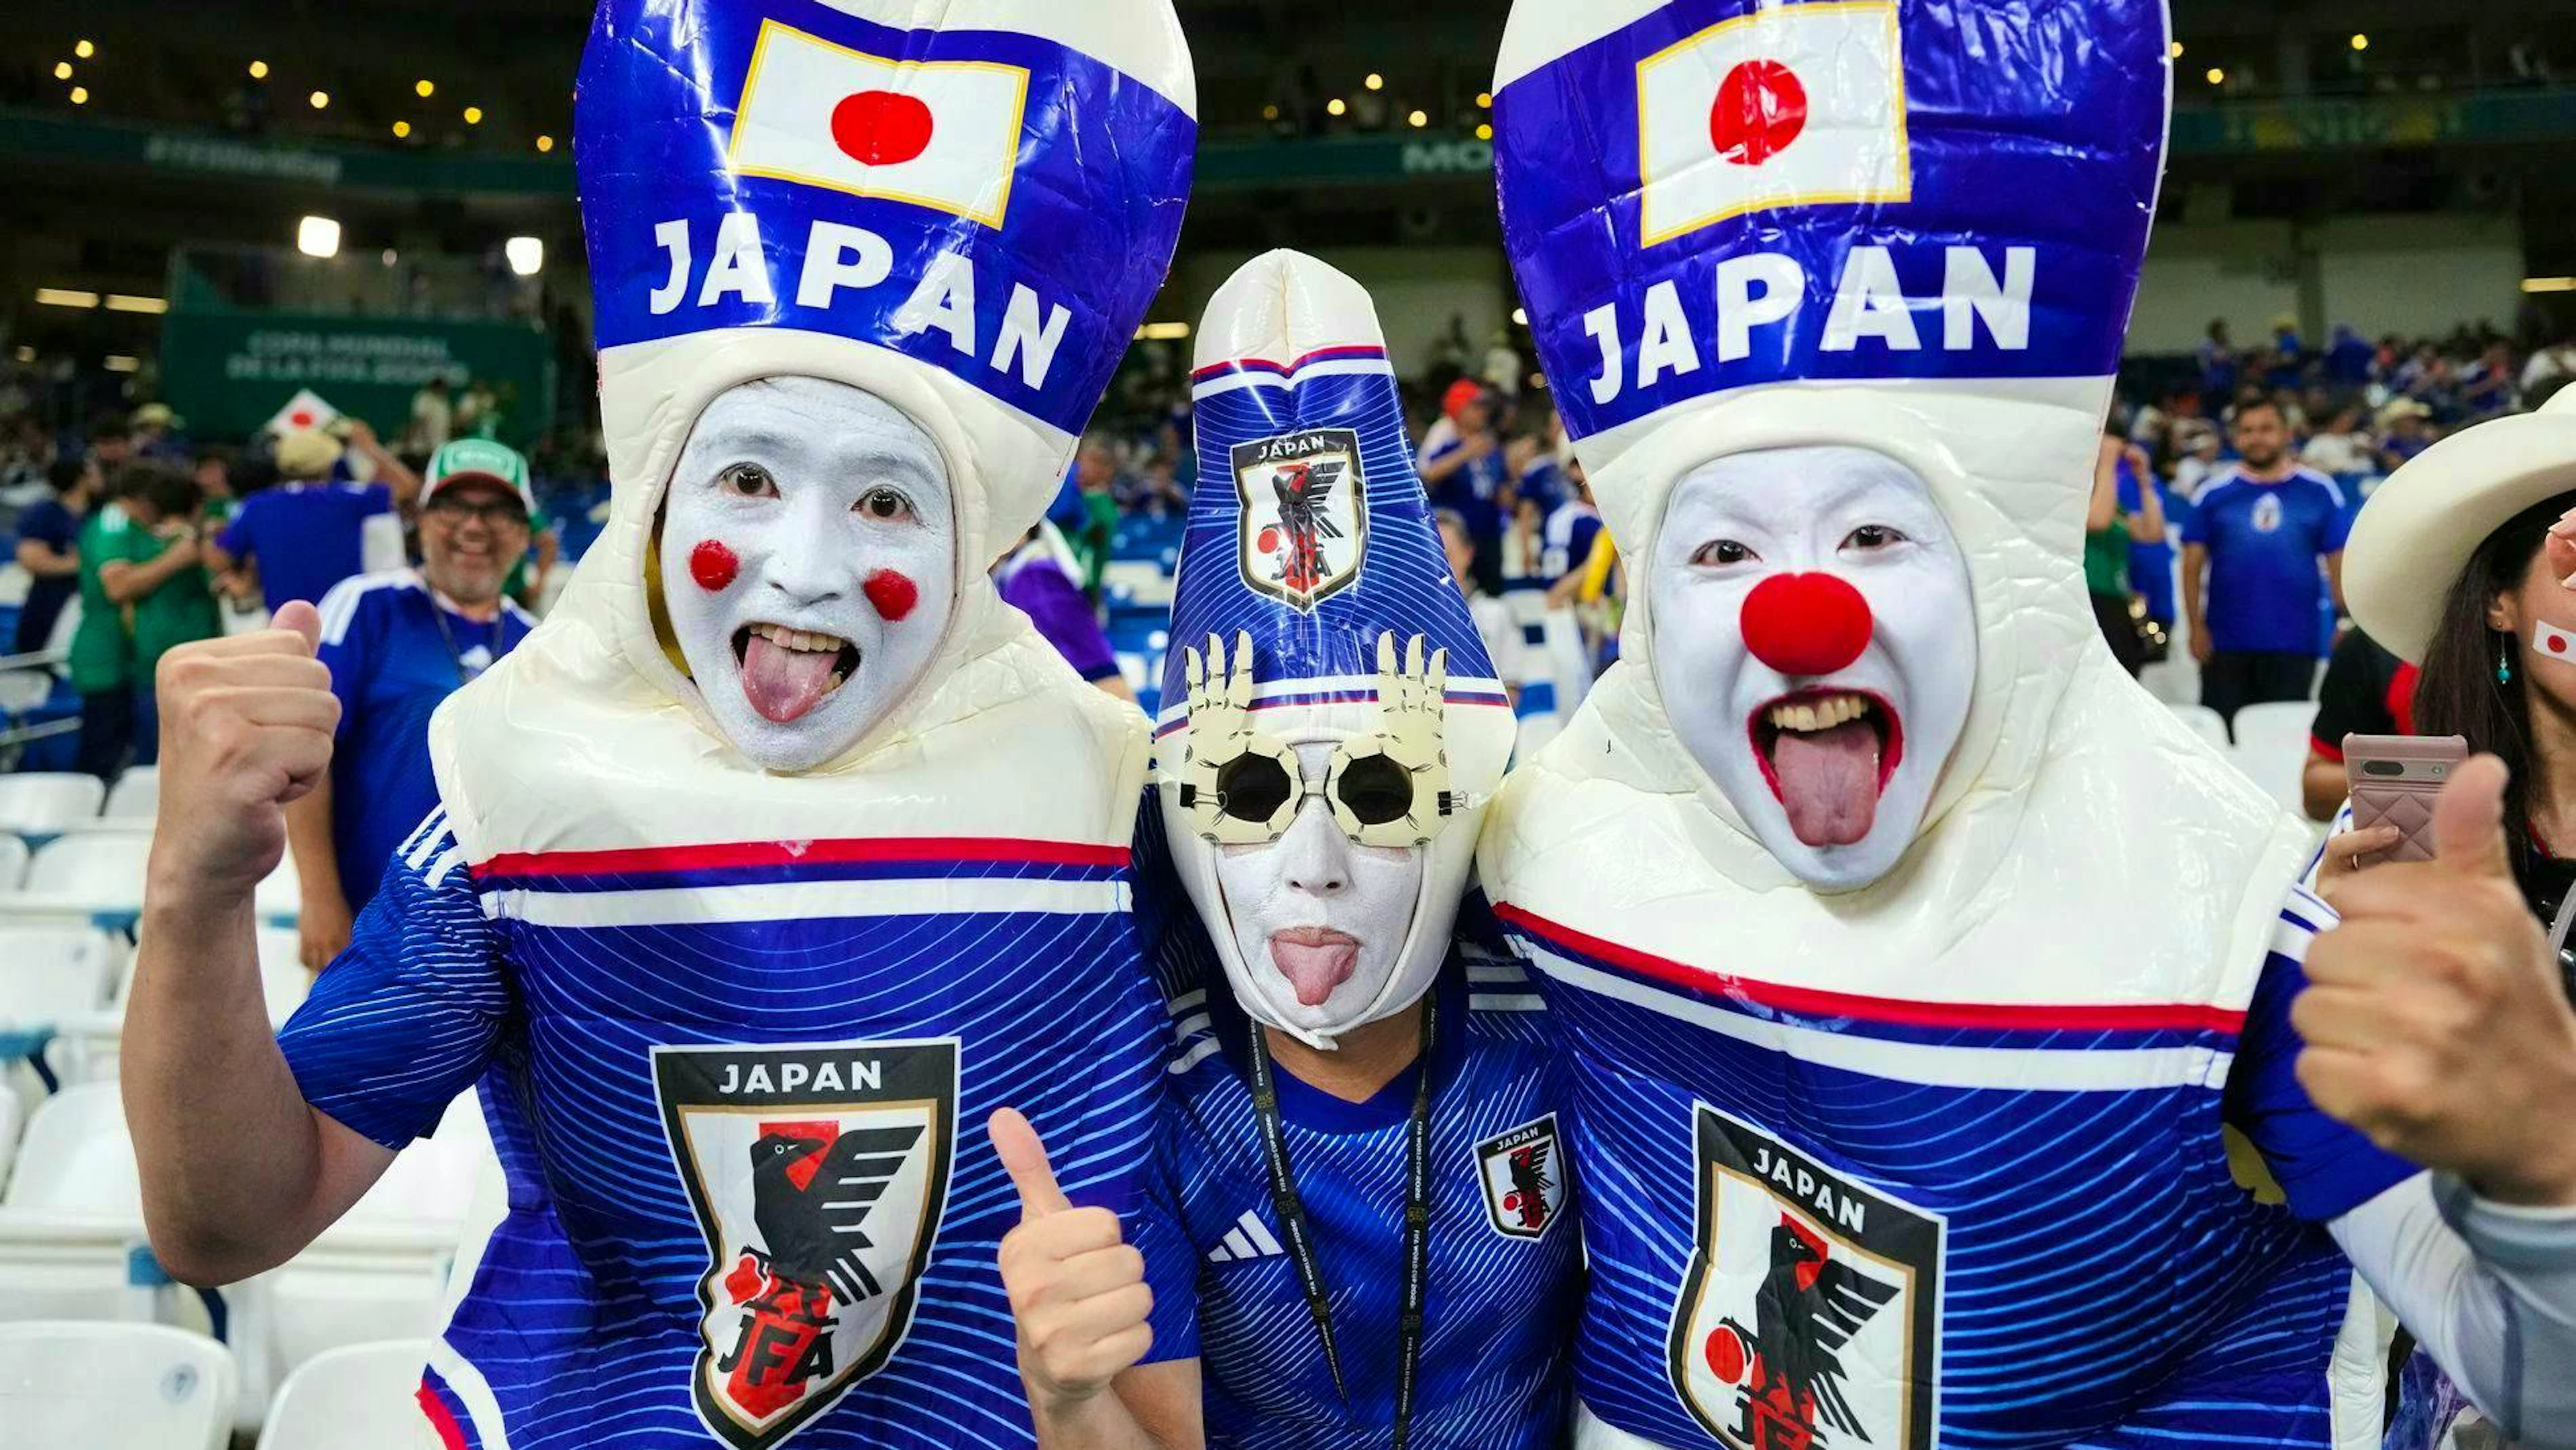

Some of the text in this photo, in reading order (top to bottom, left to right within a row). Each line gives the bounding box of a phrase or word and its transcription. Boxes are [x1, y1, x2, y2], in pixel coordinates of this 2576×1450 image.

[649, 212, 1072, 391] JAPAN
[1583, 246, 2036, 405] JAPAN
[1258, 435, 1325, 460] JAPAN
[719, 1060, 881, 1094] JAPAN
[1497, 1127, 1539, 1151] JAPAN
[1273, 1153, 1284, 1178] WORLD
[1279, 1177, 1287, 1192] FIFA
[1753, 1148, 1866, 1233] JAPAN
[1302, 1257, 1313, 1281] WORLD
[1309, 1281, 1318, 1296] FIFA
[717, 1312, 835, 1386] JFA
